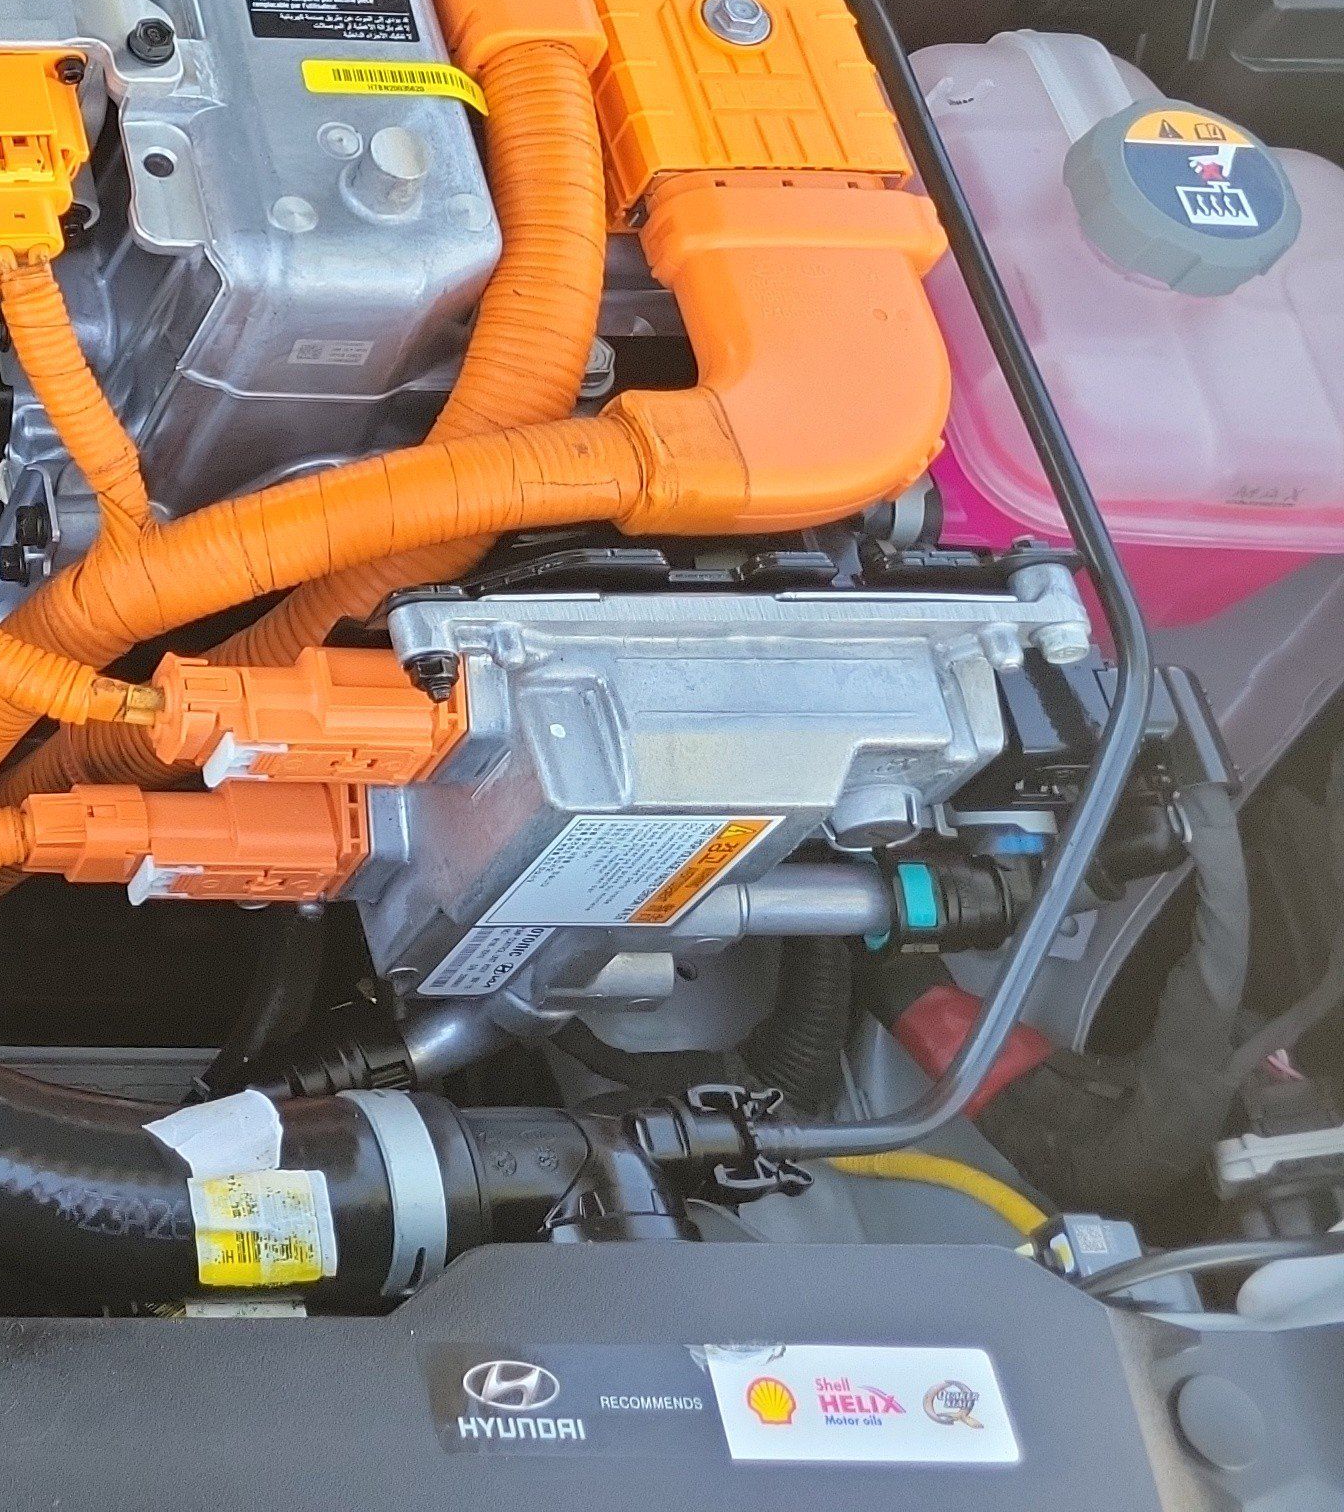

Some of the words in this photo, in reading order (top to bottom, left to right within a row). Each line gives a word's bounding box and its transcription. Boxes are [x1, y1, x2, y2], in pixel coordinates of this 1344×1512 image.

[815, 1377, 850, 1392] Shell
[818, 1392, 907, 1414] HELIX
[457, 1416, 587, 1440] HYUNDAI
[600, 1395, 704, 1411] RECOMMENDS
[824, 1415, 860, 1426] Motor
[862, 1415, 883, 1426] oils
